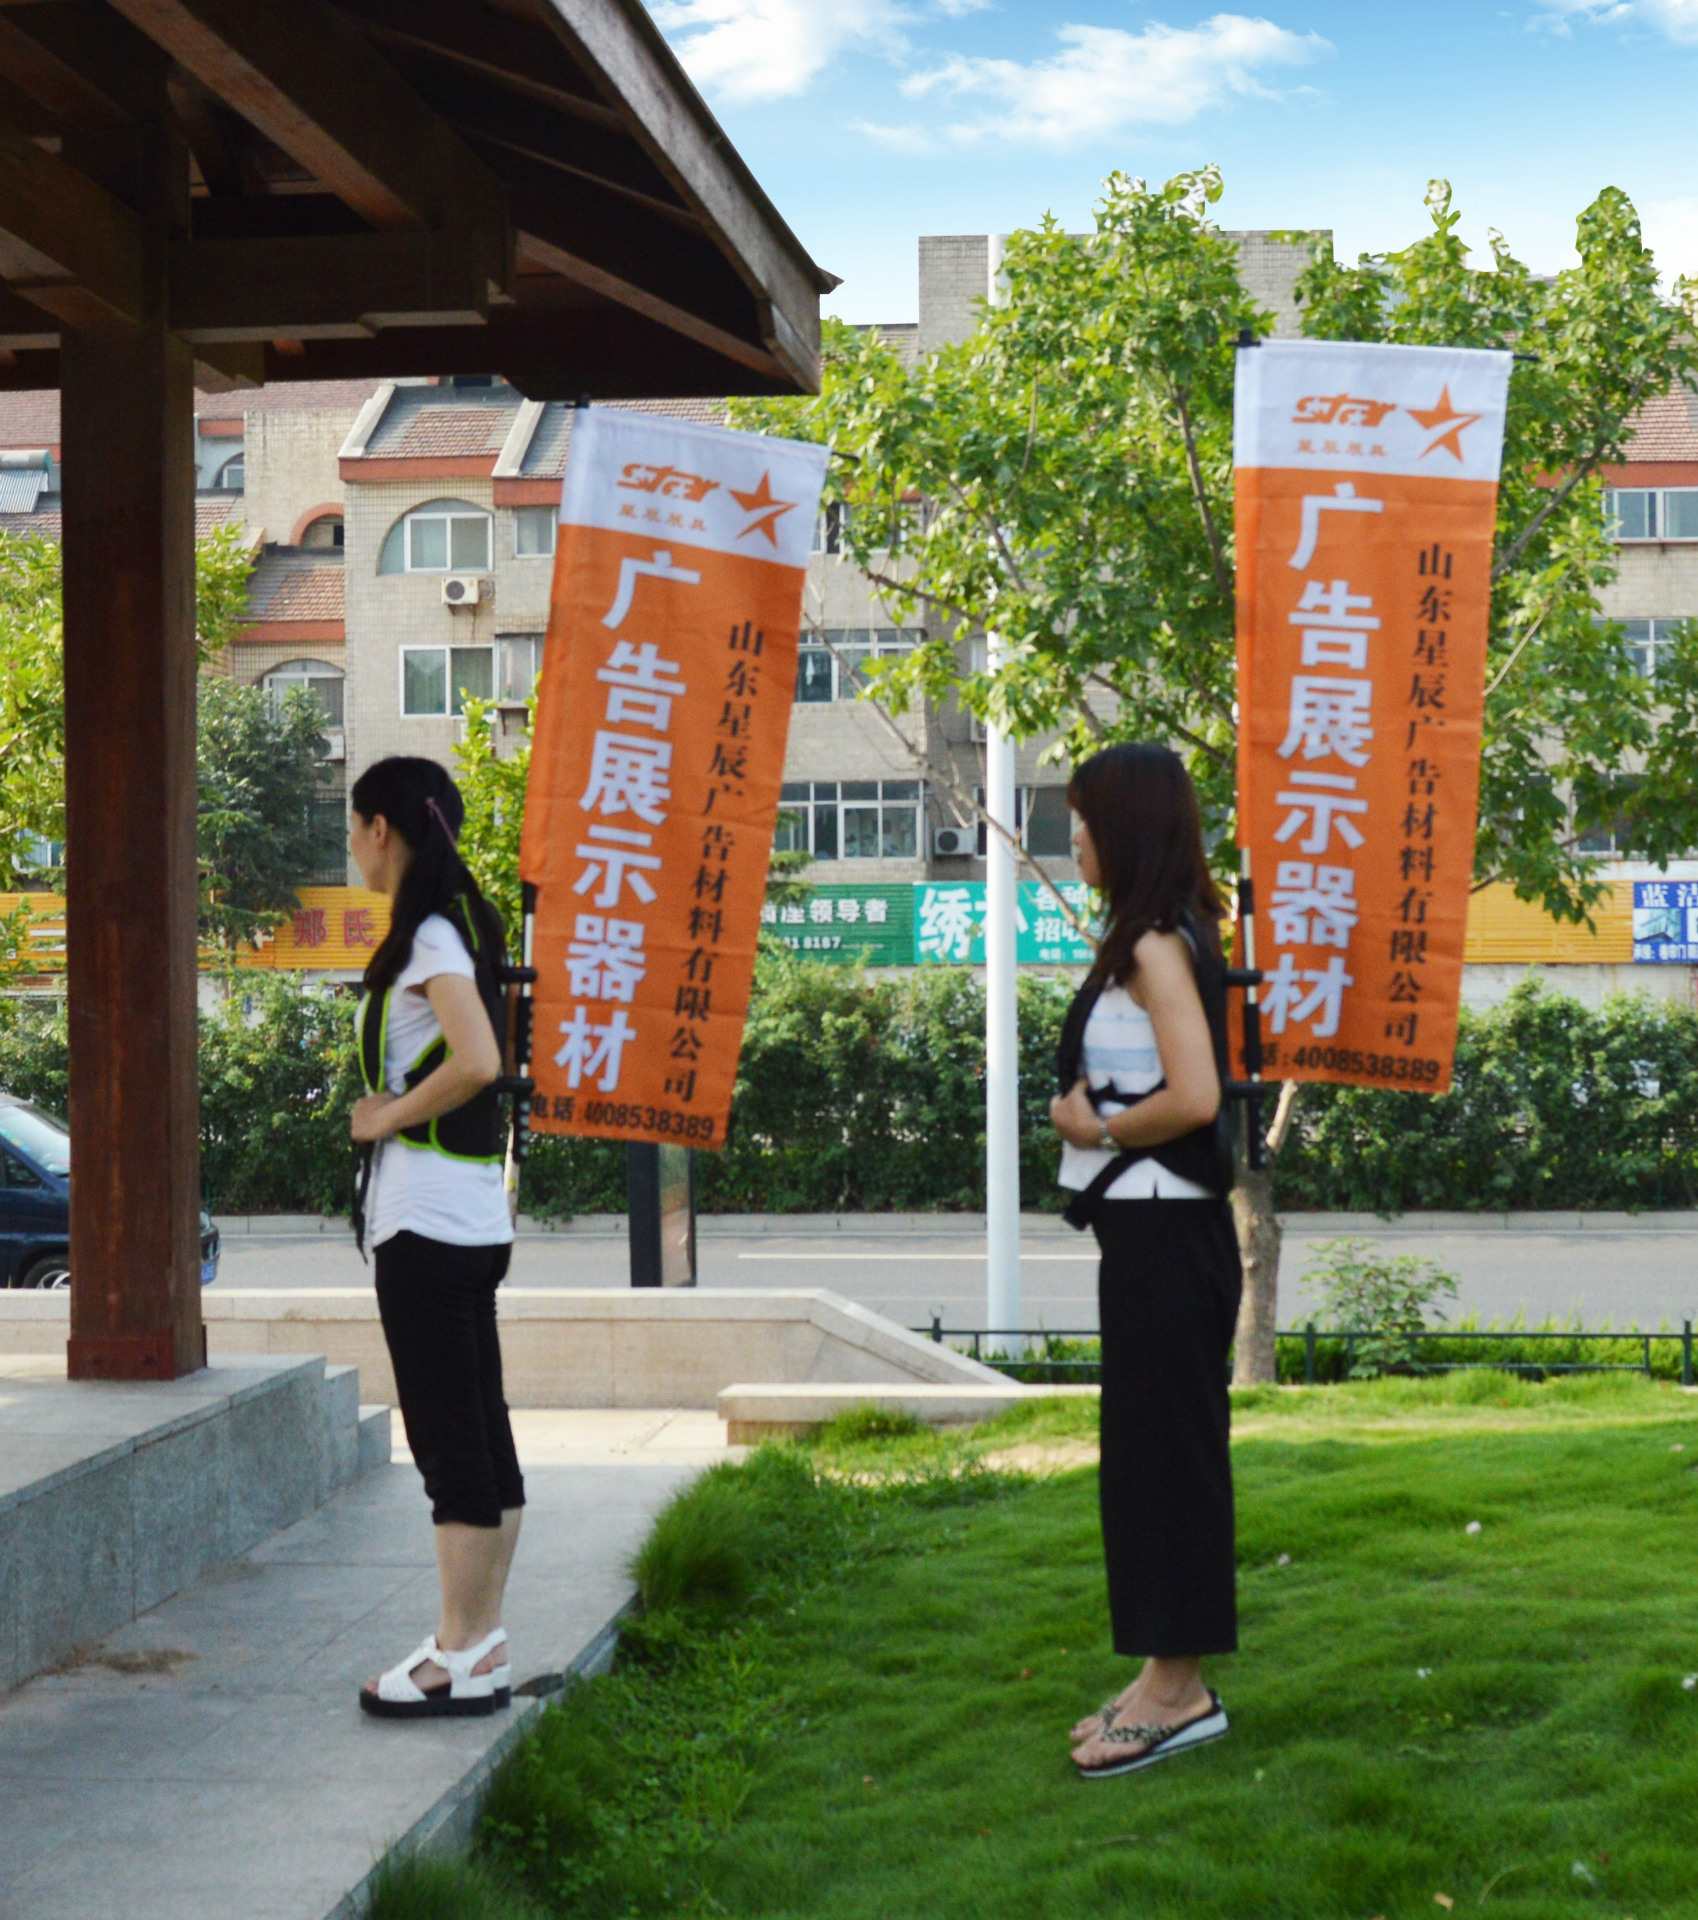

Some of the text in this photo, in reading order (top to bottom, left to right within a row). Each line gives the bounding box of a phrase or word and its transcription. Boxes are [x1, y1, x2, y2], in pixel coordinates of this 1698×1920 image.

[293, 908, 376, 948] 郑氏
[554, 551, 701, 1093] 广告展示器材
[664, 620, 764, 1102] 山东星辰广告材料有限公司
[1260, 481, 1384, 1038] 广告展示器材
[1384, 543, 1452, 1046] 山东星辰广告材料有限公司
